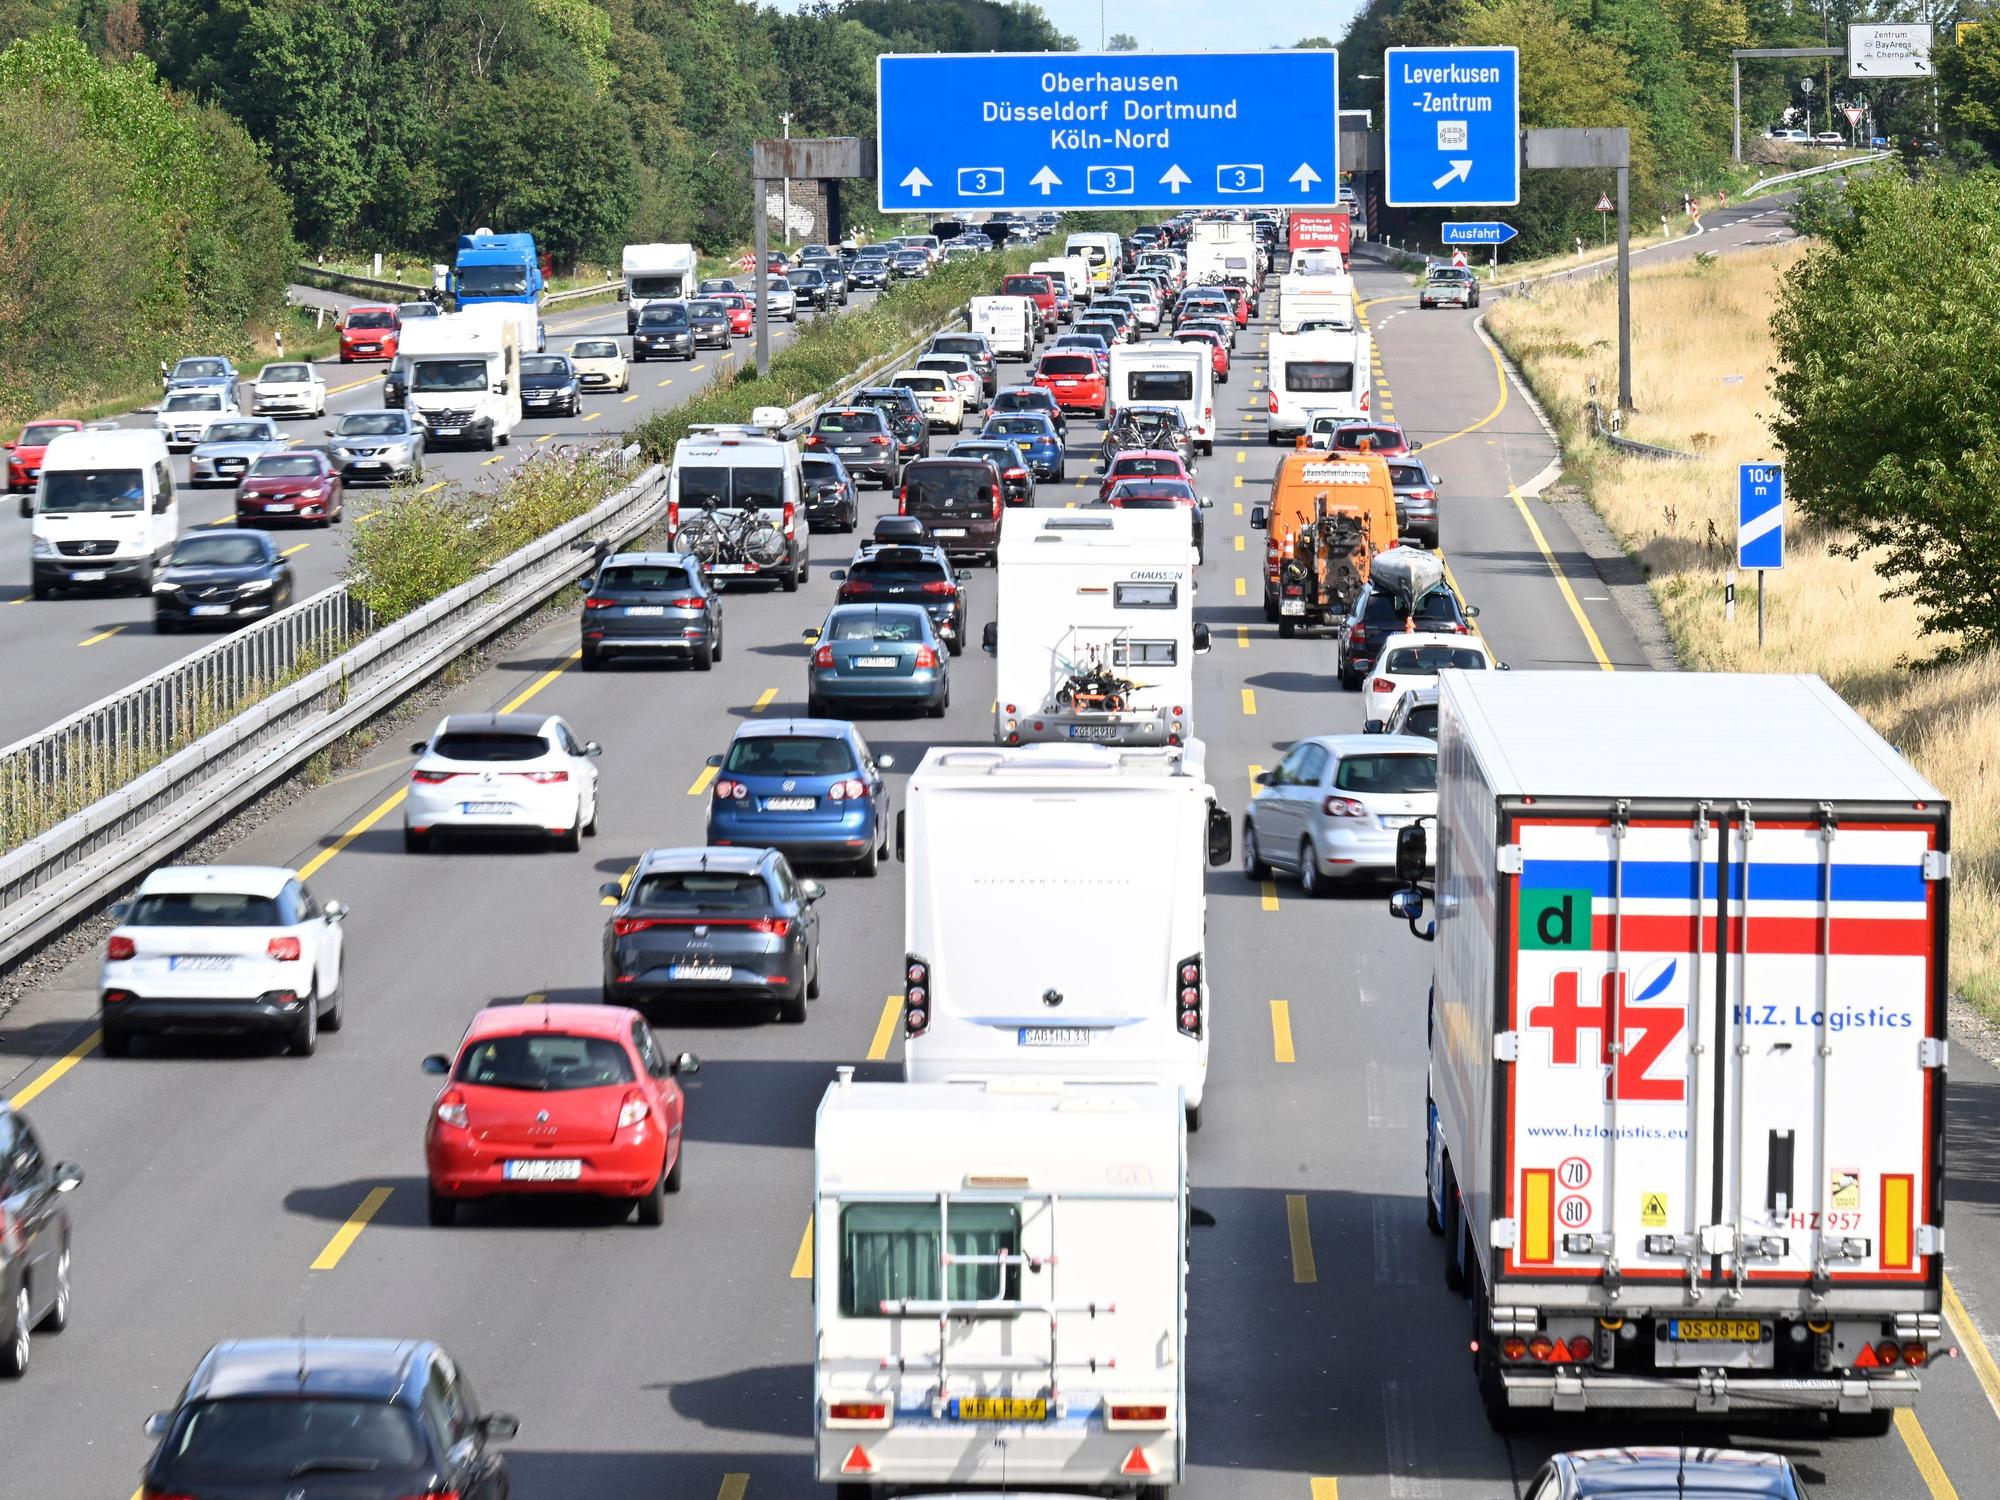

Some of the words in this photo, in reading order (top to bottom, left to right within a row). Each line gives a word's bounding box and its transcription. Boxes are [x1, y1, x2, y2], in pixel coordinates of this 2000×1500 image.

[1041, 72, 1179, 93] Oberhausen
[1404, 63, 1500, 84] Leverkusen
[983, 100, 1108, 122] Düsseldorf
[1124, 99, 1238, 121] Dortmund
[1413, 92, 1492, 112] -Zentrum
[1051, 128, 1170, 150] Köln-Nord
[976, 173, 987, 191] 3
[1105, 171, 1116, 190] 3
[1235, 170, 1246, 188] 3
[1312, 232, 1339, 242] Penny
[1450, 227, 1501, 239] Ausfahrt
[1755, 486, 1766, 495] m
[1130, 571, 1183, 580] CHAUSSON
[1537, 896, 1573, 944] d
[1733, 1005, 1786, 1025] H.Z.
[1796, 1005, 1912, 1031] Logistics
[1528, 1124, 1689, 1141] www.hzlogistics.eu
[1566, 1163, 1583, 1183] 70
[1566, 1201, 1583, 1222] 80
[1791, 1212, 1820, 1230] HZ
[1828, 1212, 1862, 1231] 957
